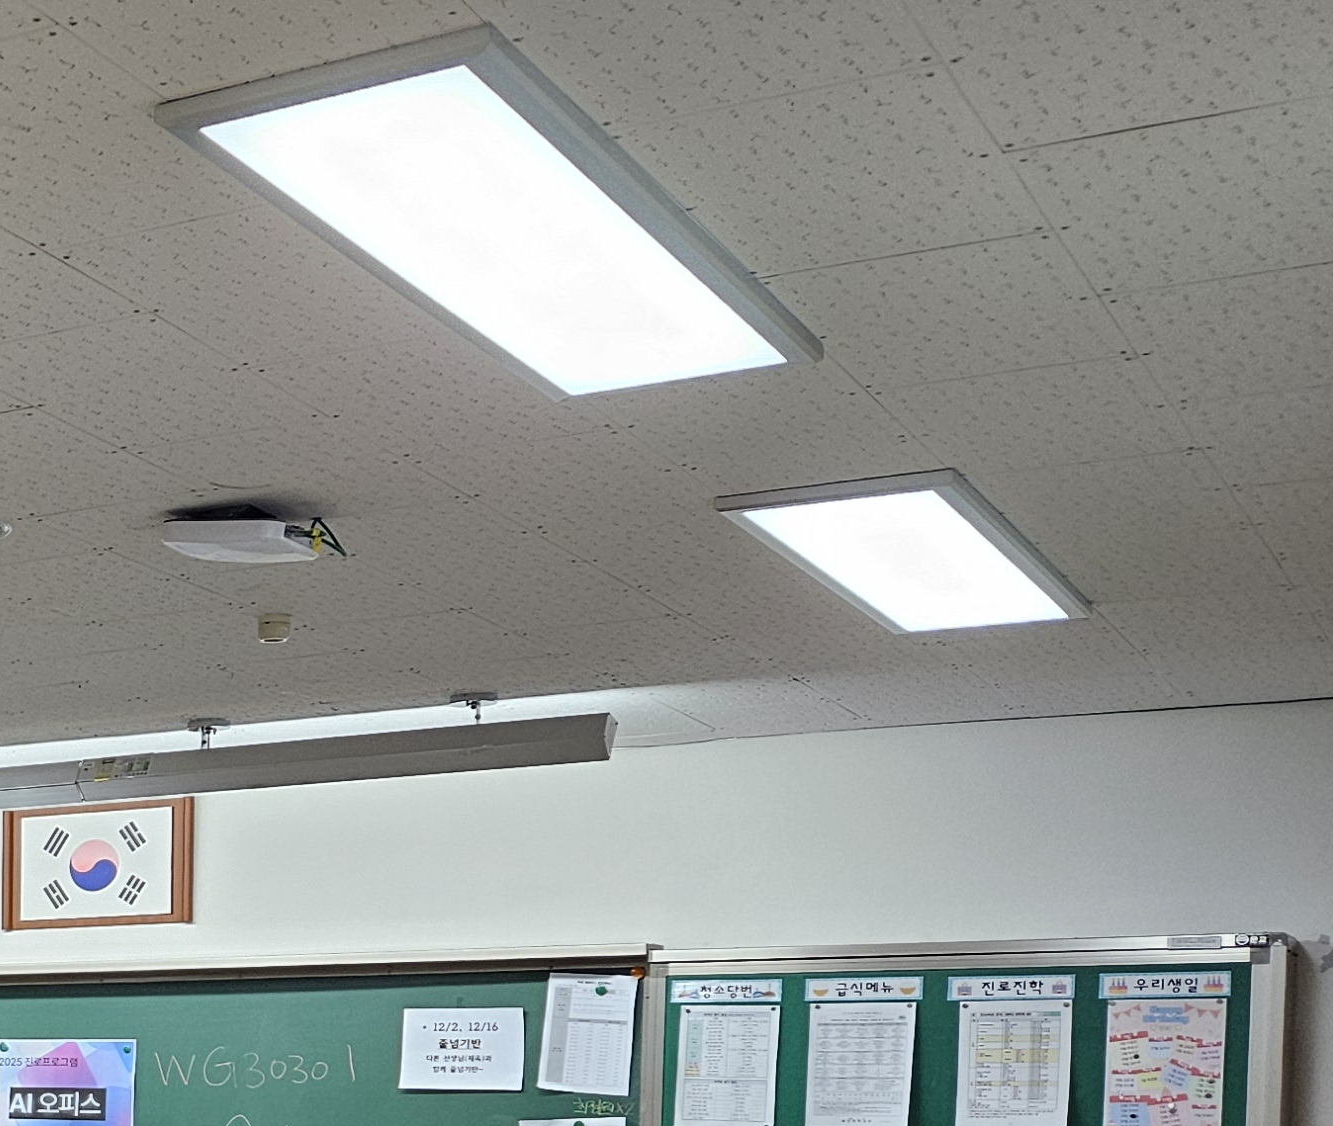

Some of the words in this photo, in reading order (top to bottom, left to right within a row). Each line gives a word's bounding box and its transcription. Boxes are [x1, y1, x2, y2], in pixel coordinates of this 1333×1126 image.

[700, 985, 753, 999] 청소당번
[836, 982, 894, 997] 급식메뉴
[981, 980, 1044, 995] 진로진학
[1133, 978, 1199, 993] 우리생일
[469, 1022, 499, 1032] 12/16
[438, 1039, 481, 1049] 줄넘기반
[0, 1058, 23, 1067] 2025
[25, 1057, 79, 1068] 진로프로그램
[9, 1092, 33, 1114] AI
[37, 1091, 102, 1117] 오피스
